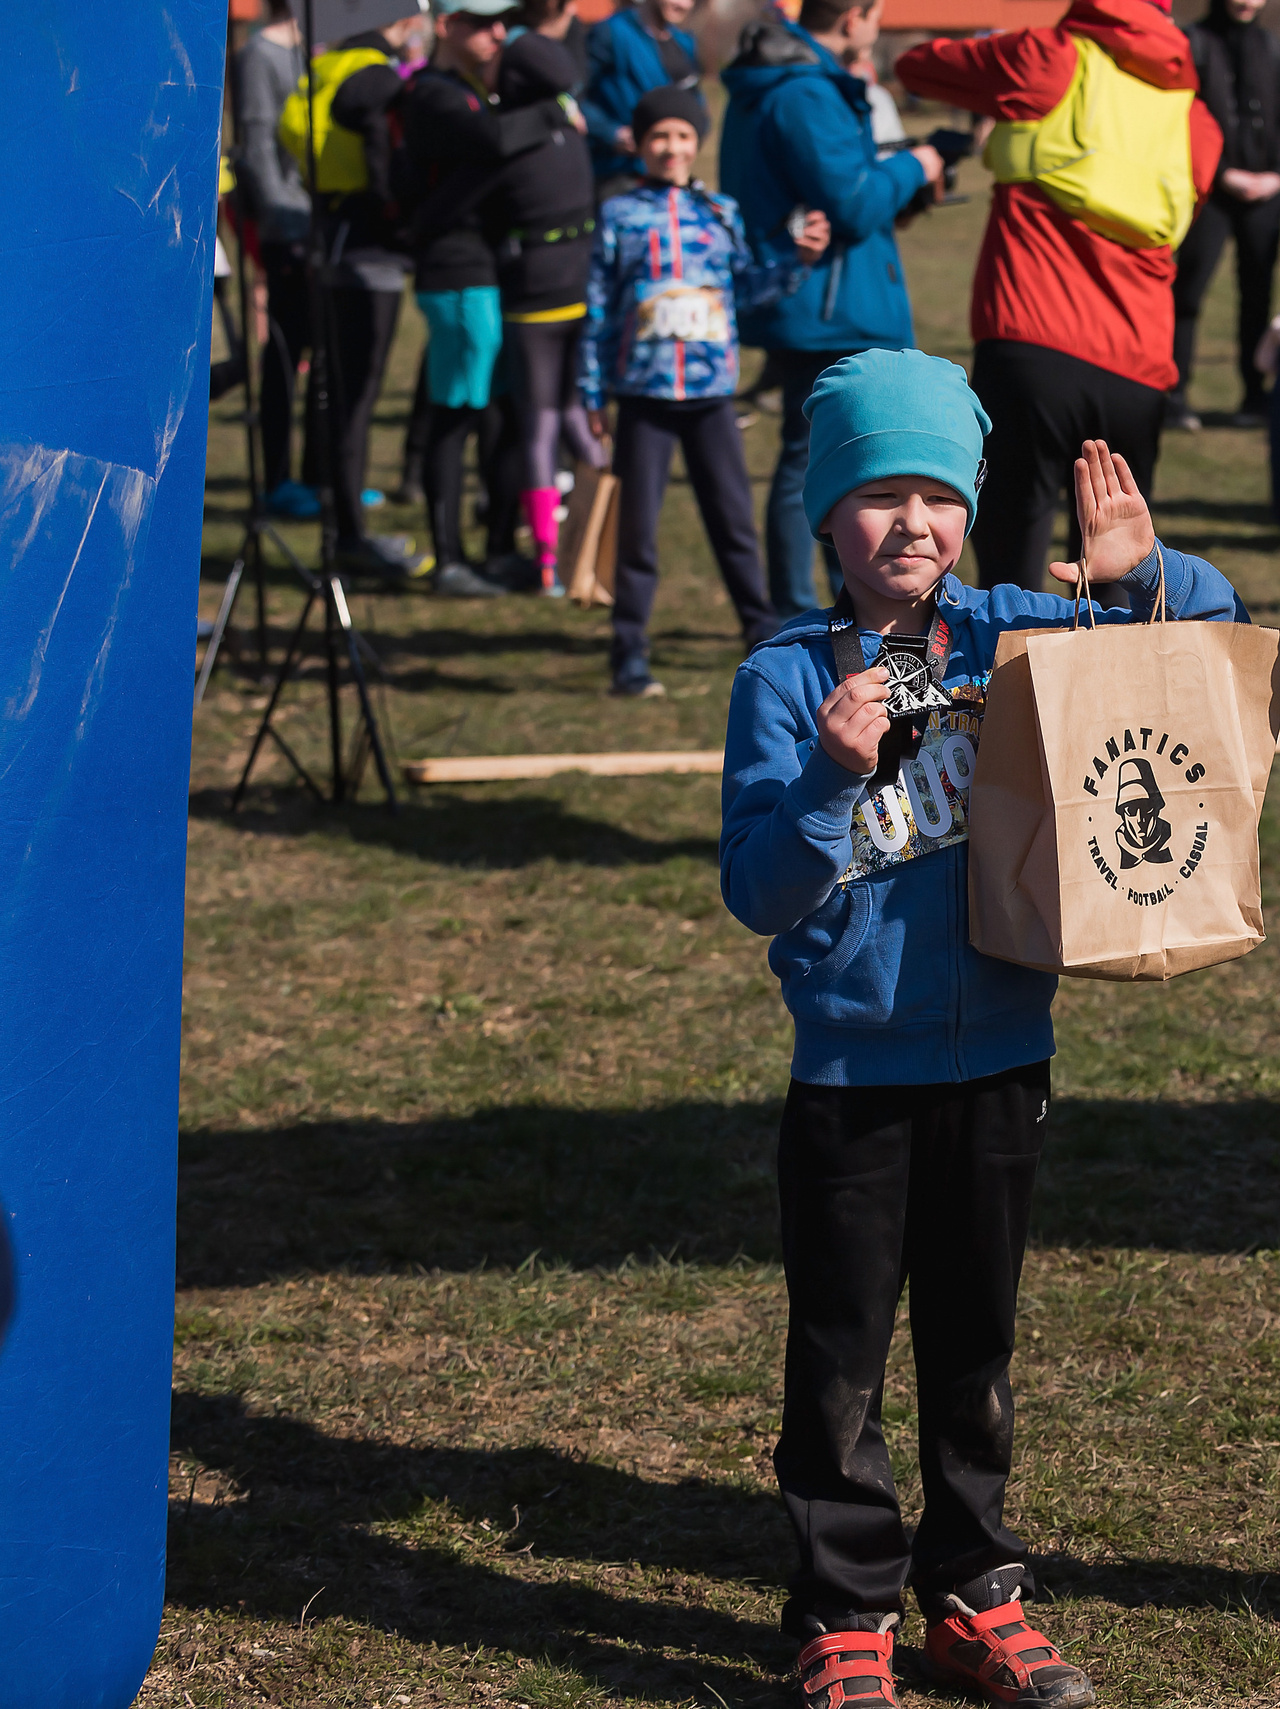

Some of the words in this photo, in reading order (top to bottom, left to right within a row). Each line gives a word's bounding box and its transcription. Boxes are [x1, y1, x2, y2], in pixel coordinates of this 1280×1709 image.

[930, 619, 950, 657] RUN
[948, 710, 980, 737] TRA
[1083, 727, 1206, 797] FANATICS
[1087, 835, 1119, 891] TRAVEL
[1127, 883, 1175, 906] FOOTBALL
[1179, 821, 1209, 879] CASUAL
